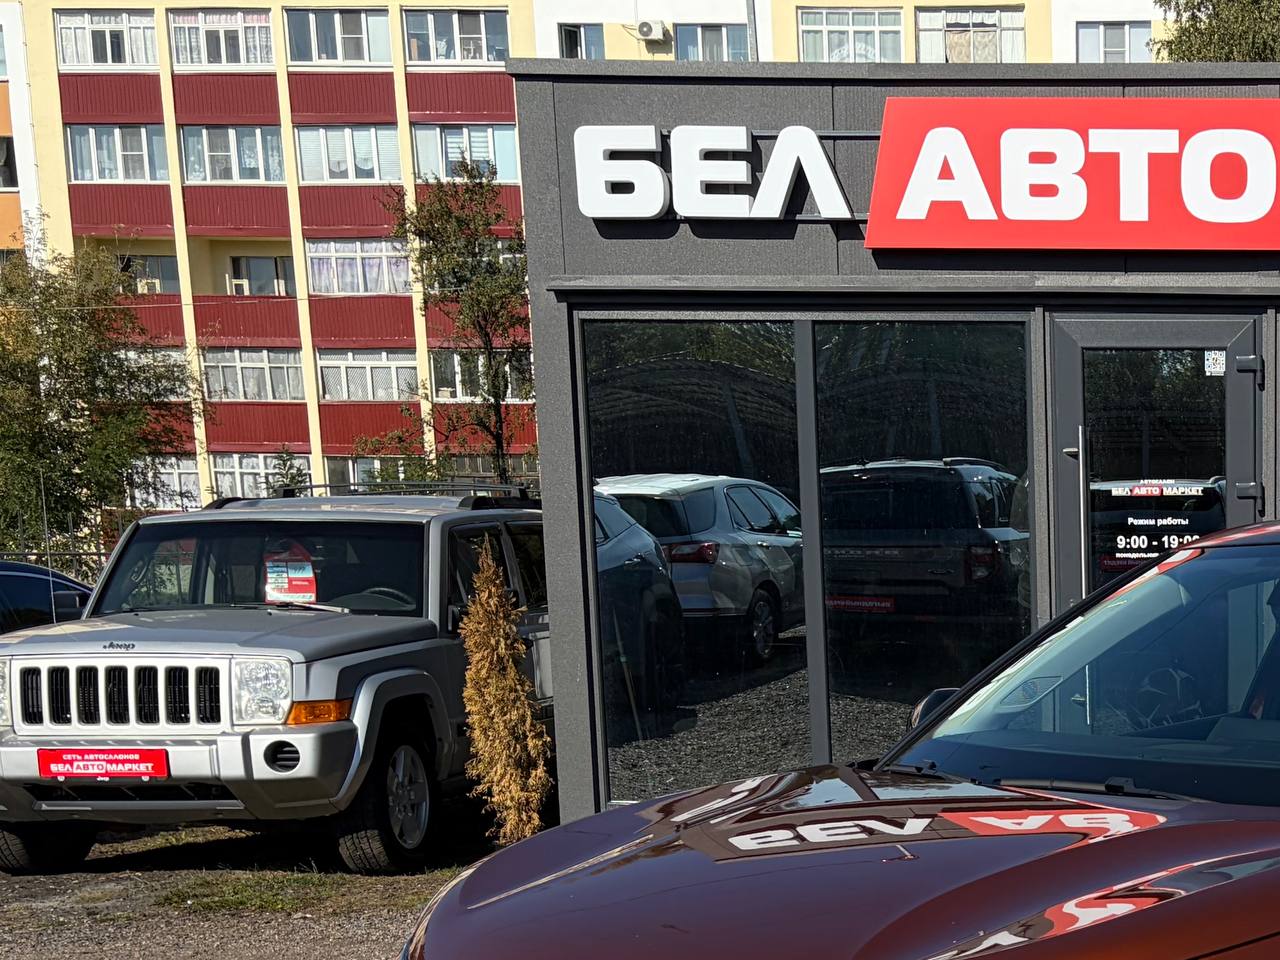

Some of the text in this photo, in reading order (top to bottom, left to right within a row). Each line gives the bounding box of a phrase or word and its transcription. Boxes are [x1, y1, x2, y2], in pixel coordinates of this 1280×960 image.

[573, 125, 852, 219] БЕЛ
[895, 127, 1277, 223] АВТО
[1112, 487, 1204, 496] БЕЛ АВТО МАРКЕТ
[1127, 517, 1189, 526] Режим работы
[1116, 535, 1148, 549] 9:00
[50, 763, 154, 772] БЕЛ АВТО МАРКЕТ
